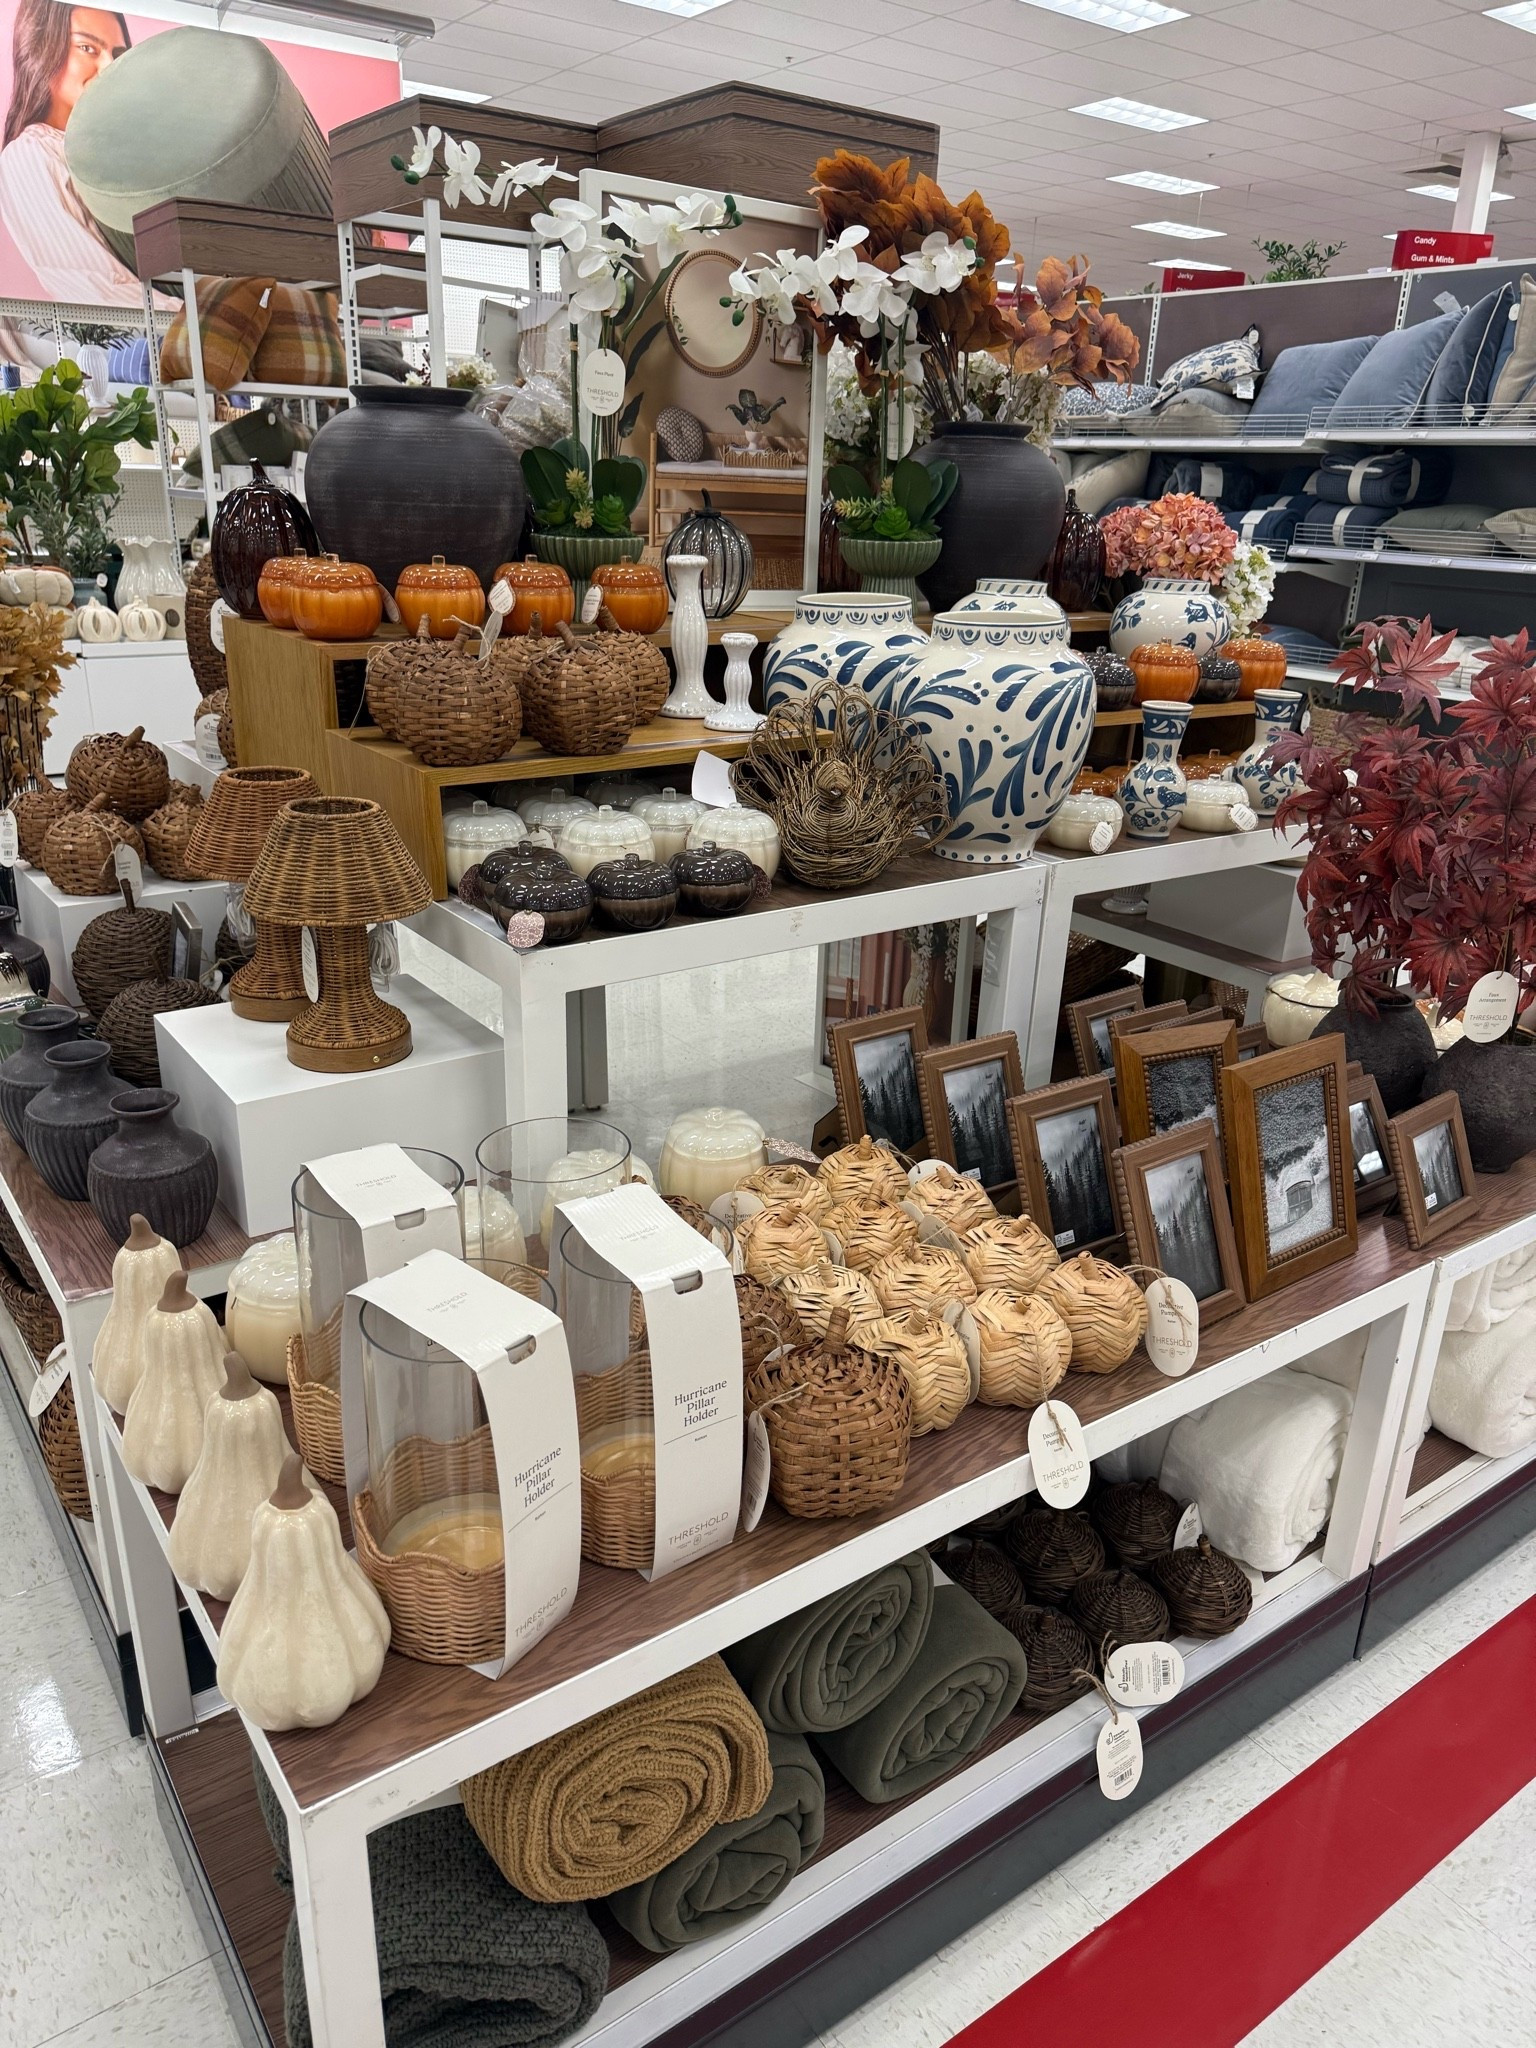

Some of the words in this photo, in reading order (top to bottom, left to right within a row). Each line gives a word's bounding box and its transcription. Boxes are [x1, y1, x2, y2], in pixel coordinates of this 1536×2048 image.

[1414, 236, 1437, 246] Candy
[1411, 254, 1427, 262] Gum
[1435, 255, 1454, 264] Mints
[1177, 272, 1194, 280] Jerky
[587, 388, 619, 398] THRESHOLD
[426, 1291, 467, 1313] THRESHOLD
[674, 1380, 728, 1406] Hurricane
[687, 1395, 716, 1414] Pillar
[684, 1406, 719, 1427] Holder
[514, 1446, 562, 1488] Hurricane
[1043, 1461, 1084, 1482] THRESHOLD
[526, 1467, 552, 1492] Pillar
[524, 1478, 555, 1508] Holder
[668, 1511, 729, 1546] THRESHOLD
[514, 1587, 567, 1638] THRESHOLD
